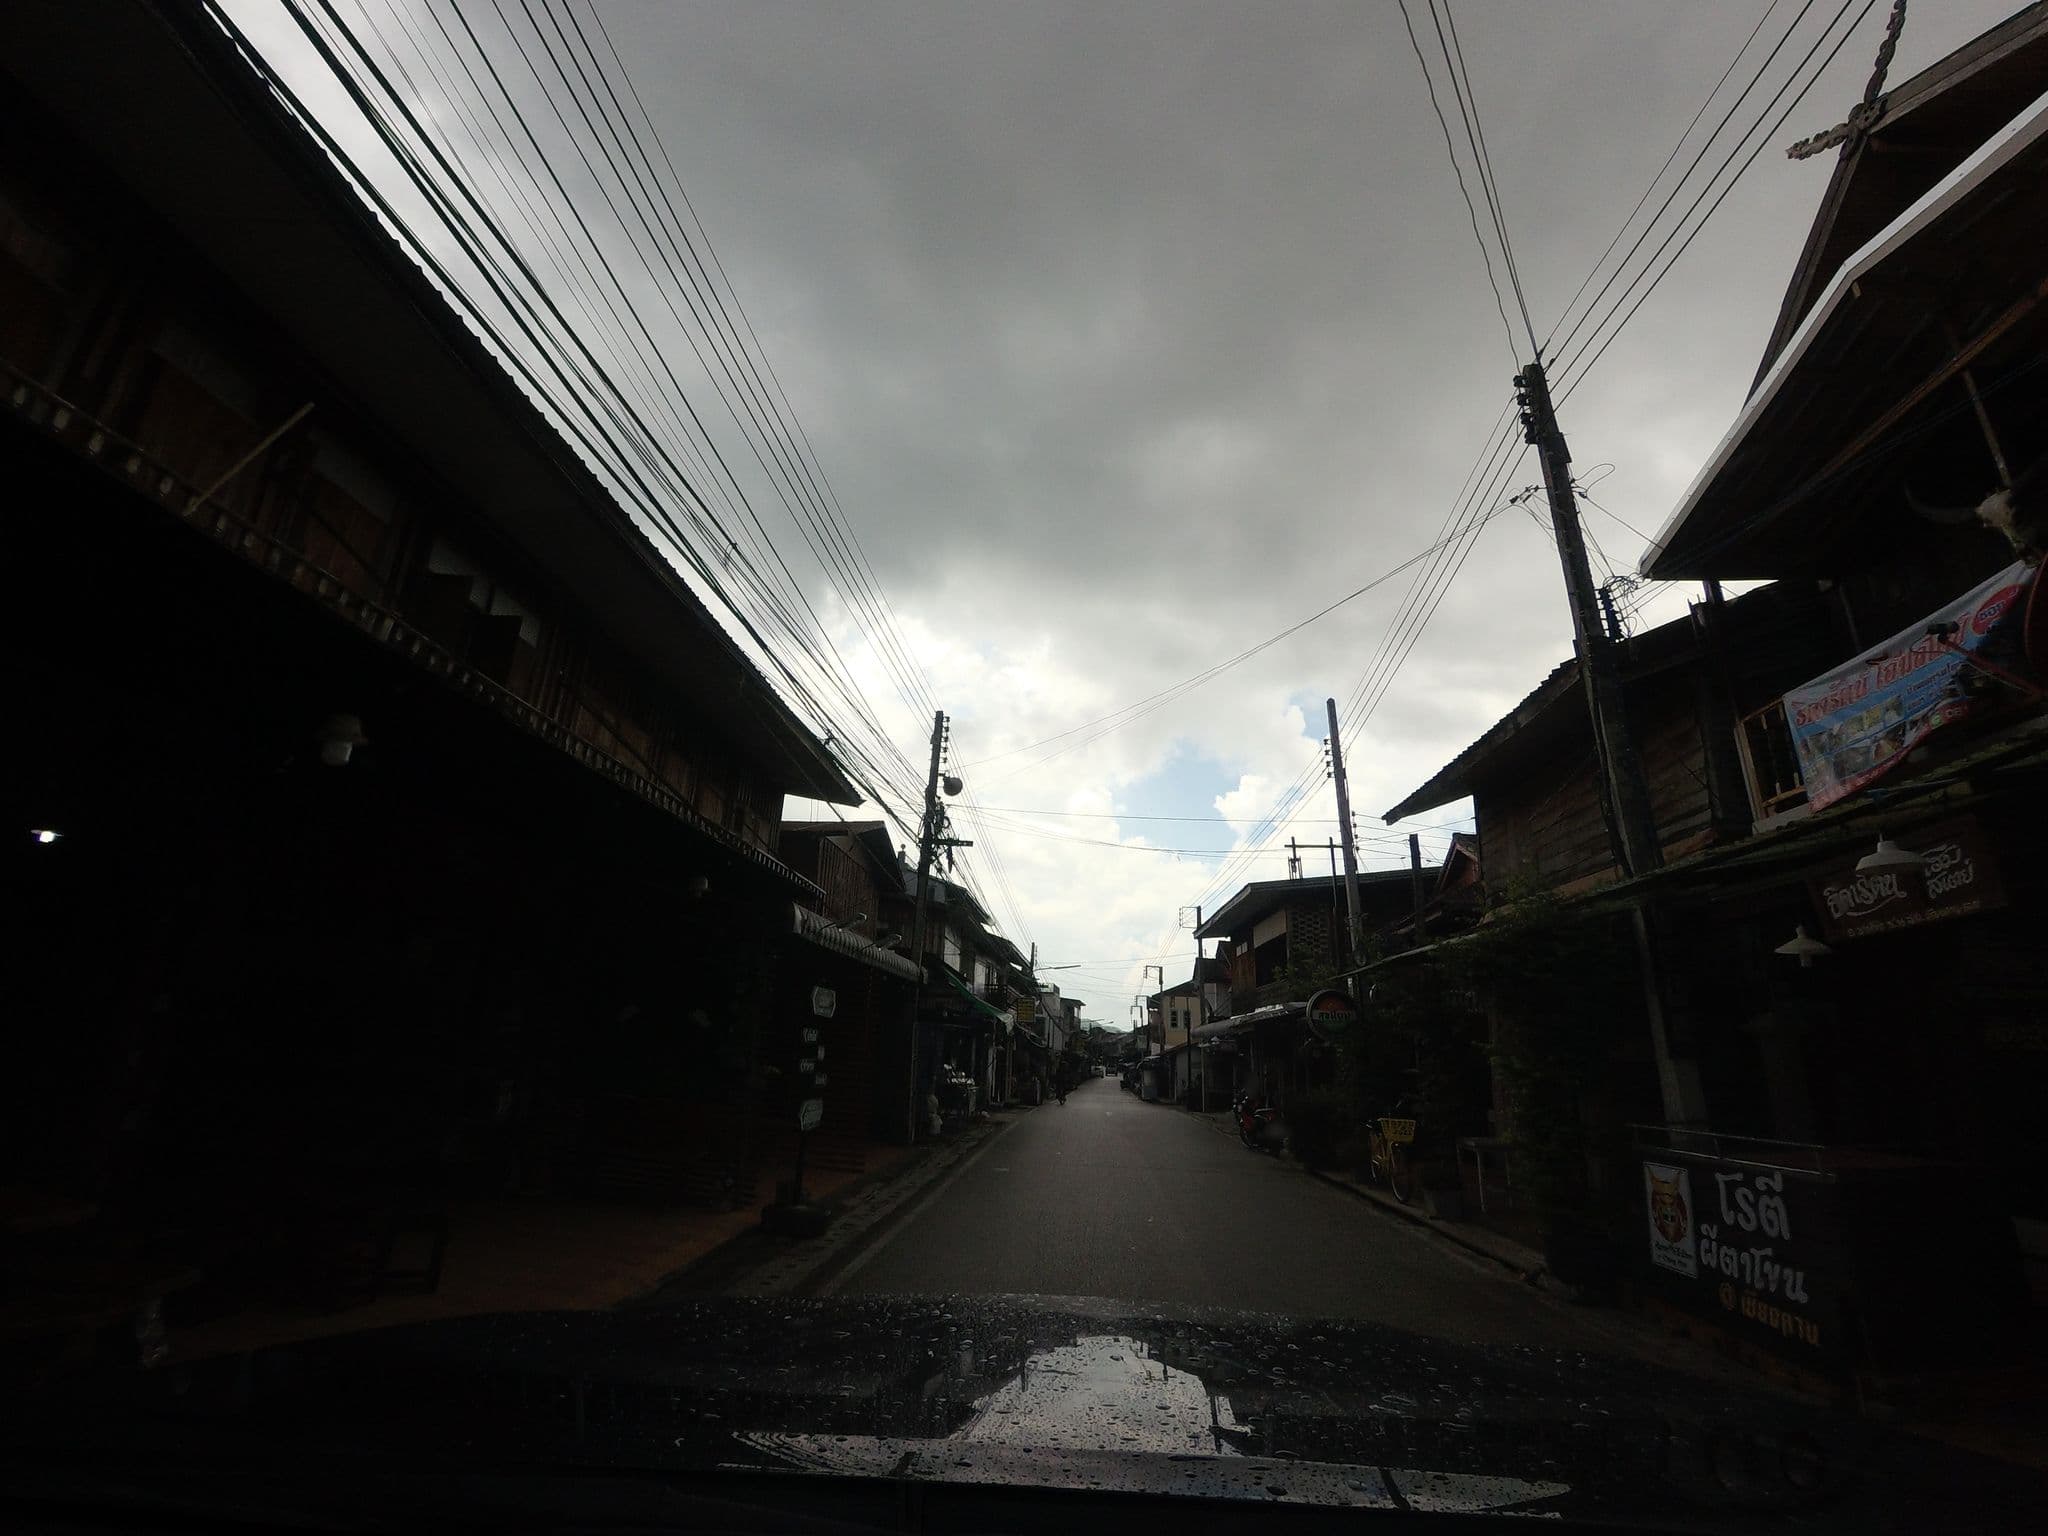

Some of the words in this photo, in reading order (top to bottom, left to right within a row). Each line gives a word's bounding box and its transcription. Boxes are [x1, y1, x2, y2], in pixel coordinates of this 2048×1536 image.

[1714, 1171, 1791, 1241] โรตี
[1700, 1223, 1809, 1304] ผีตาโขน
